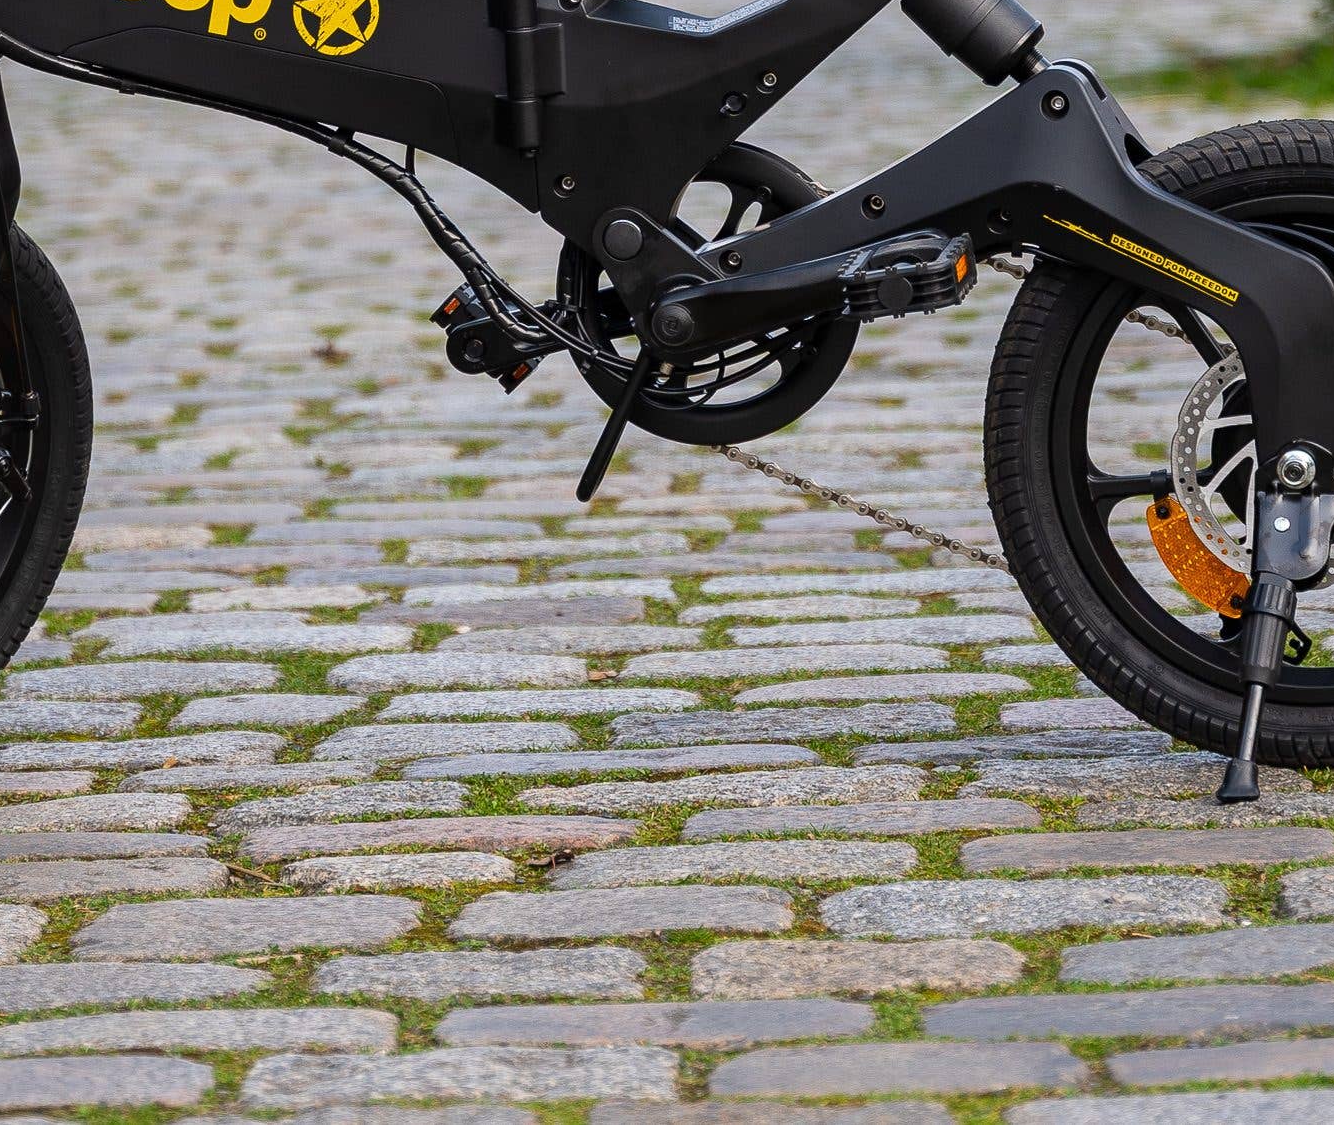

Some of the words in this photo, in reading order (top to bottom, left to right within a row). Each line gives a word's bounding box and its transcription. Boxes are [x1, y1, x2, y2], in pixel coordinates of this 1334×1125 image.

[1112, 235, 1163, 265] DESIGNED
[1165, 260, 1185, 275] FOR
[1187, 271, 1237, 300] FREEDOM
